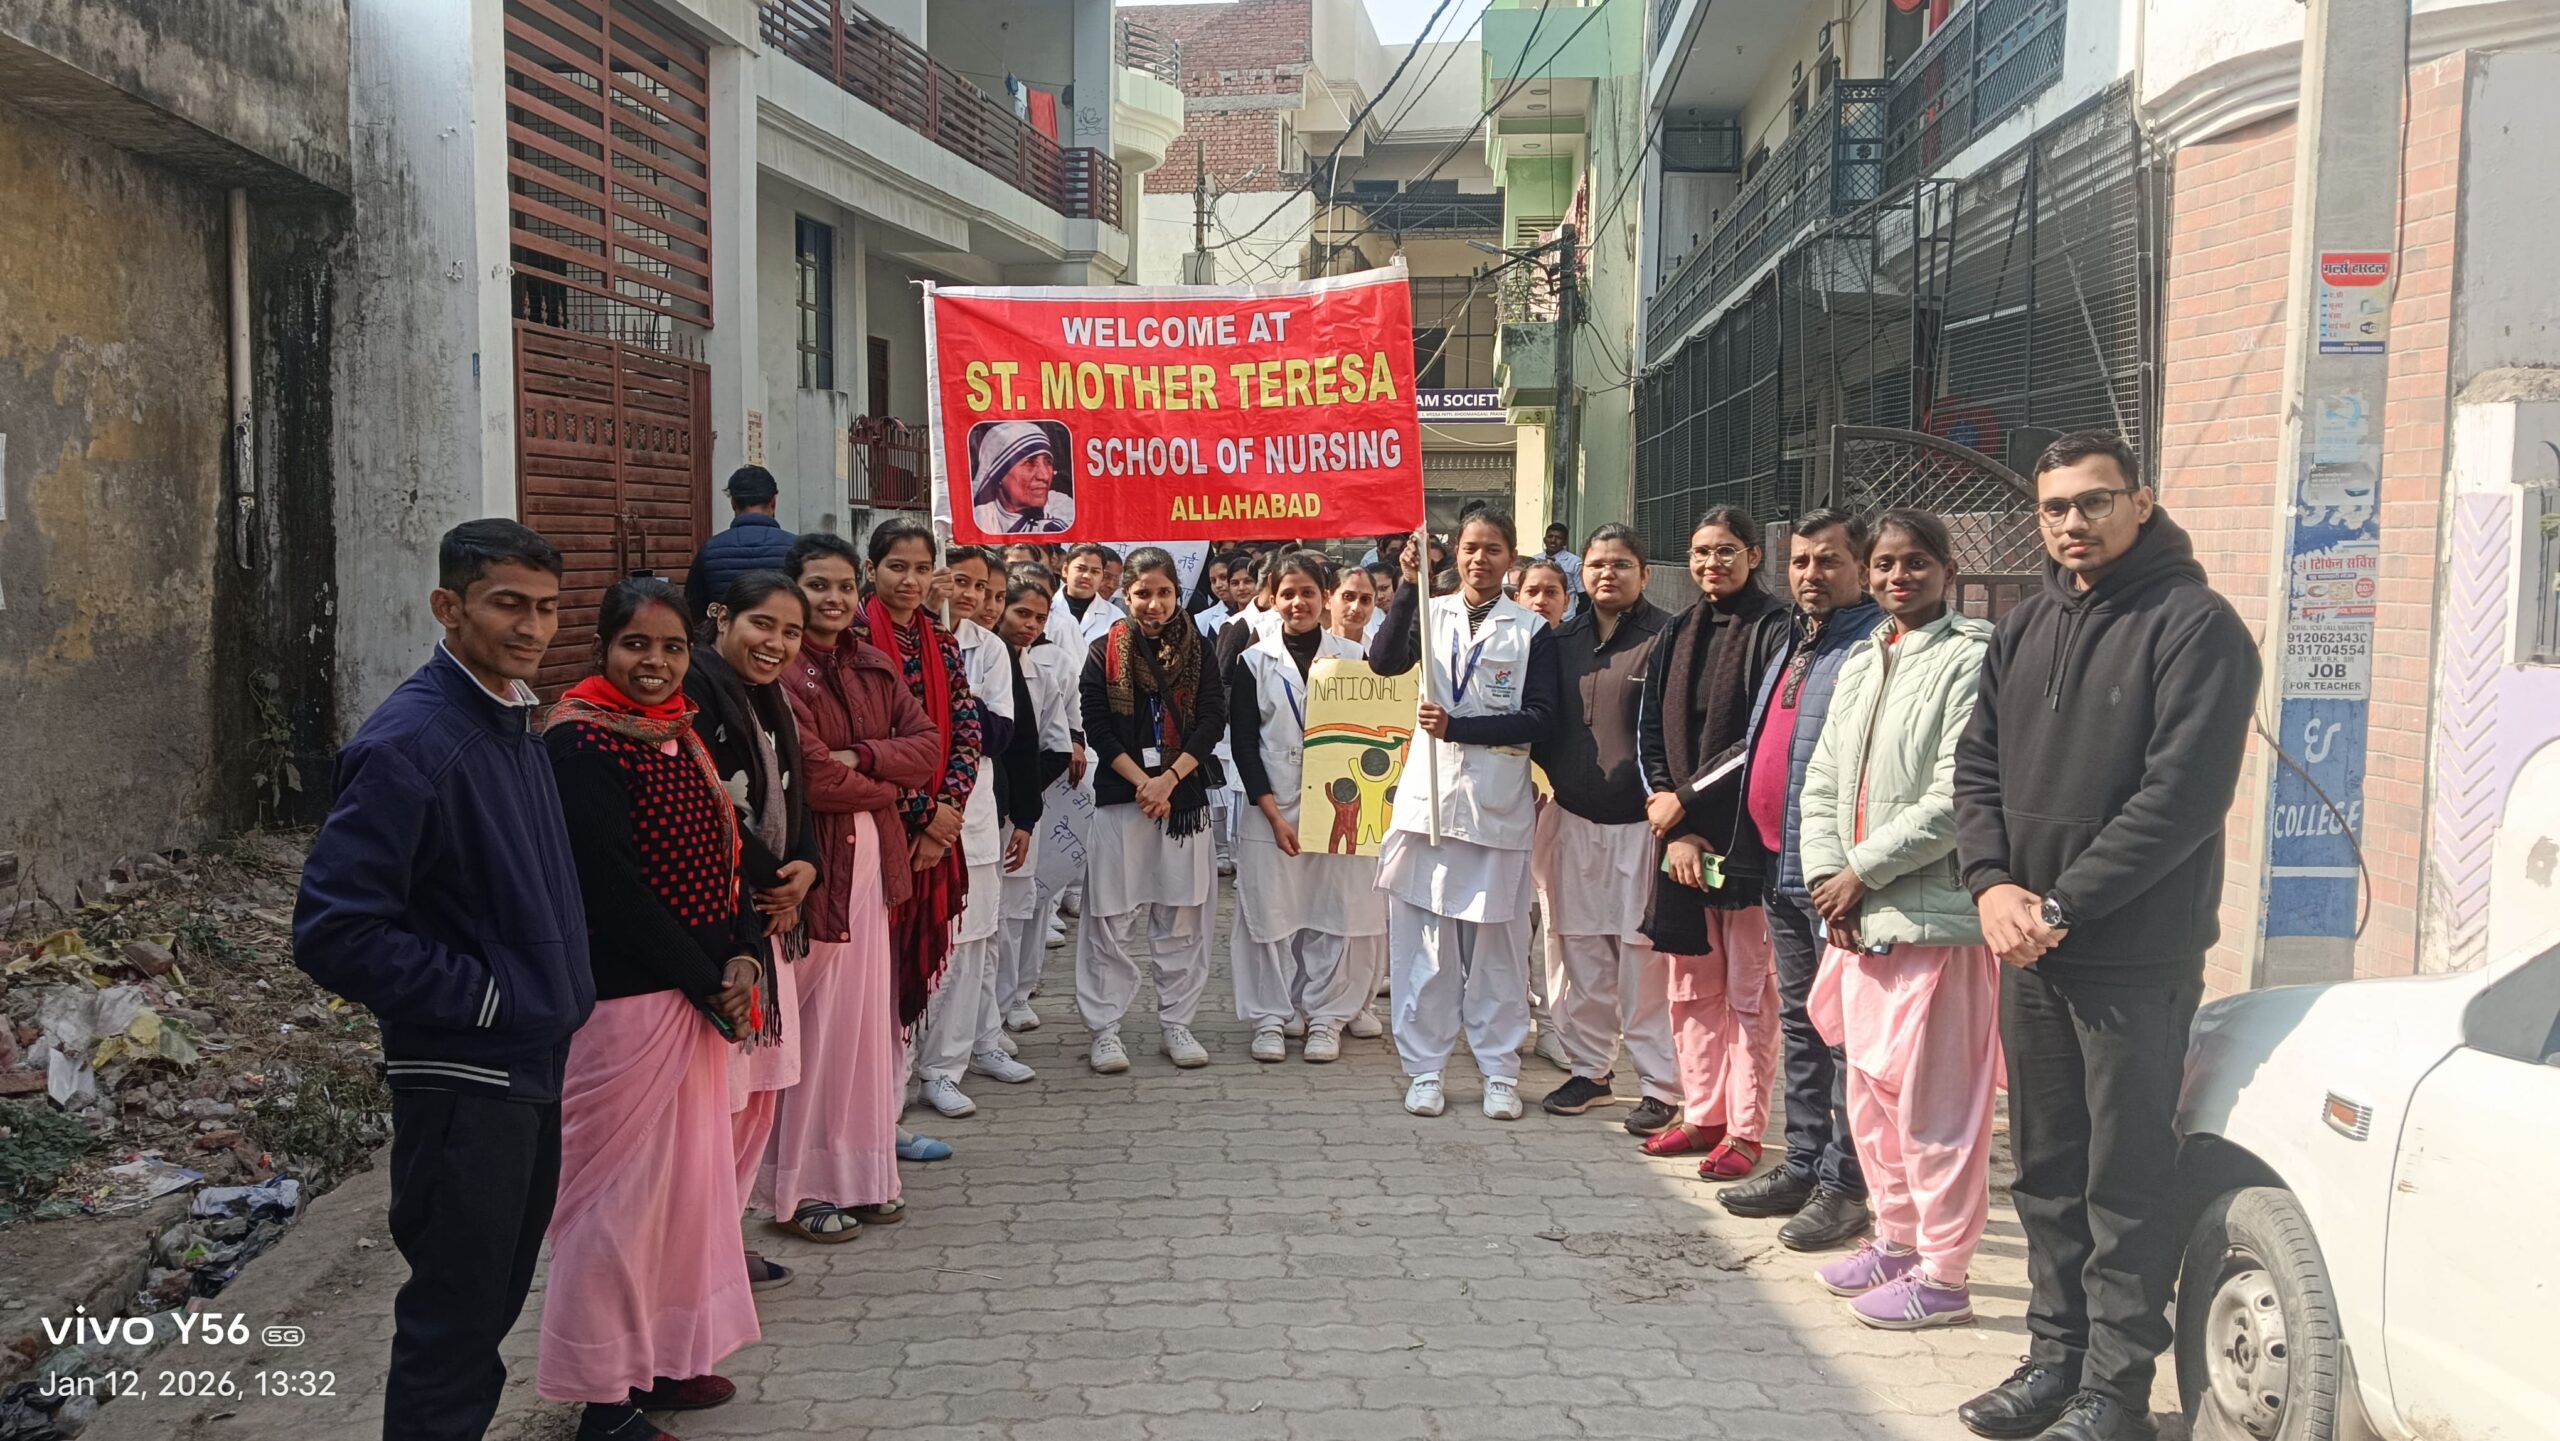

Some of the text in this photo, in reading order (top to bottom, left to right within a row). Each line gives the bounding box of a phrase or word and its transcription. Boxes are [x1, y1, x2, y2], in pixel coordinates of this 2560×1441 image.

[1061, 311, 1291, 348] WELCOME AT
[965, 351, 1397, 412] ST. MOTHER TERESA
[1086, 428, 1401, 477] SCHOOL OF NURSING
[1170, 492, 1321, 521] ALLAHABAD
[2290, 682, 2361, 690] FOR TEACHER
[2308, 664, 2347, 678] JOB
[1314, 676, 1401, 702] NATIONAL
[2274, 800, 2361, 839] COLLEGE
